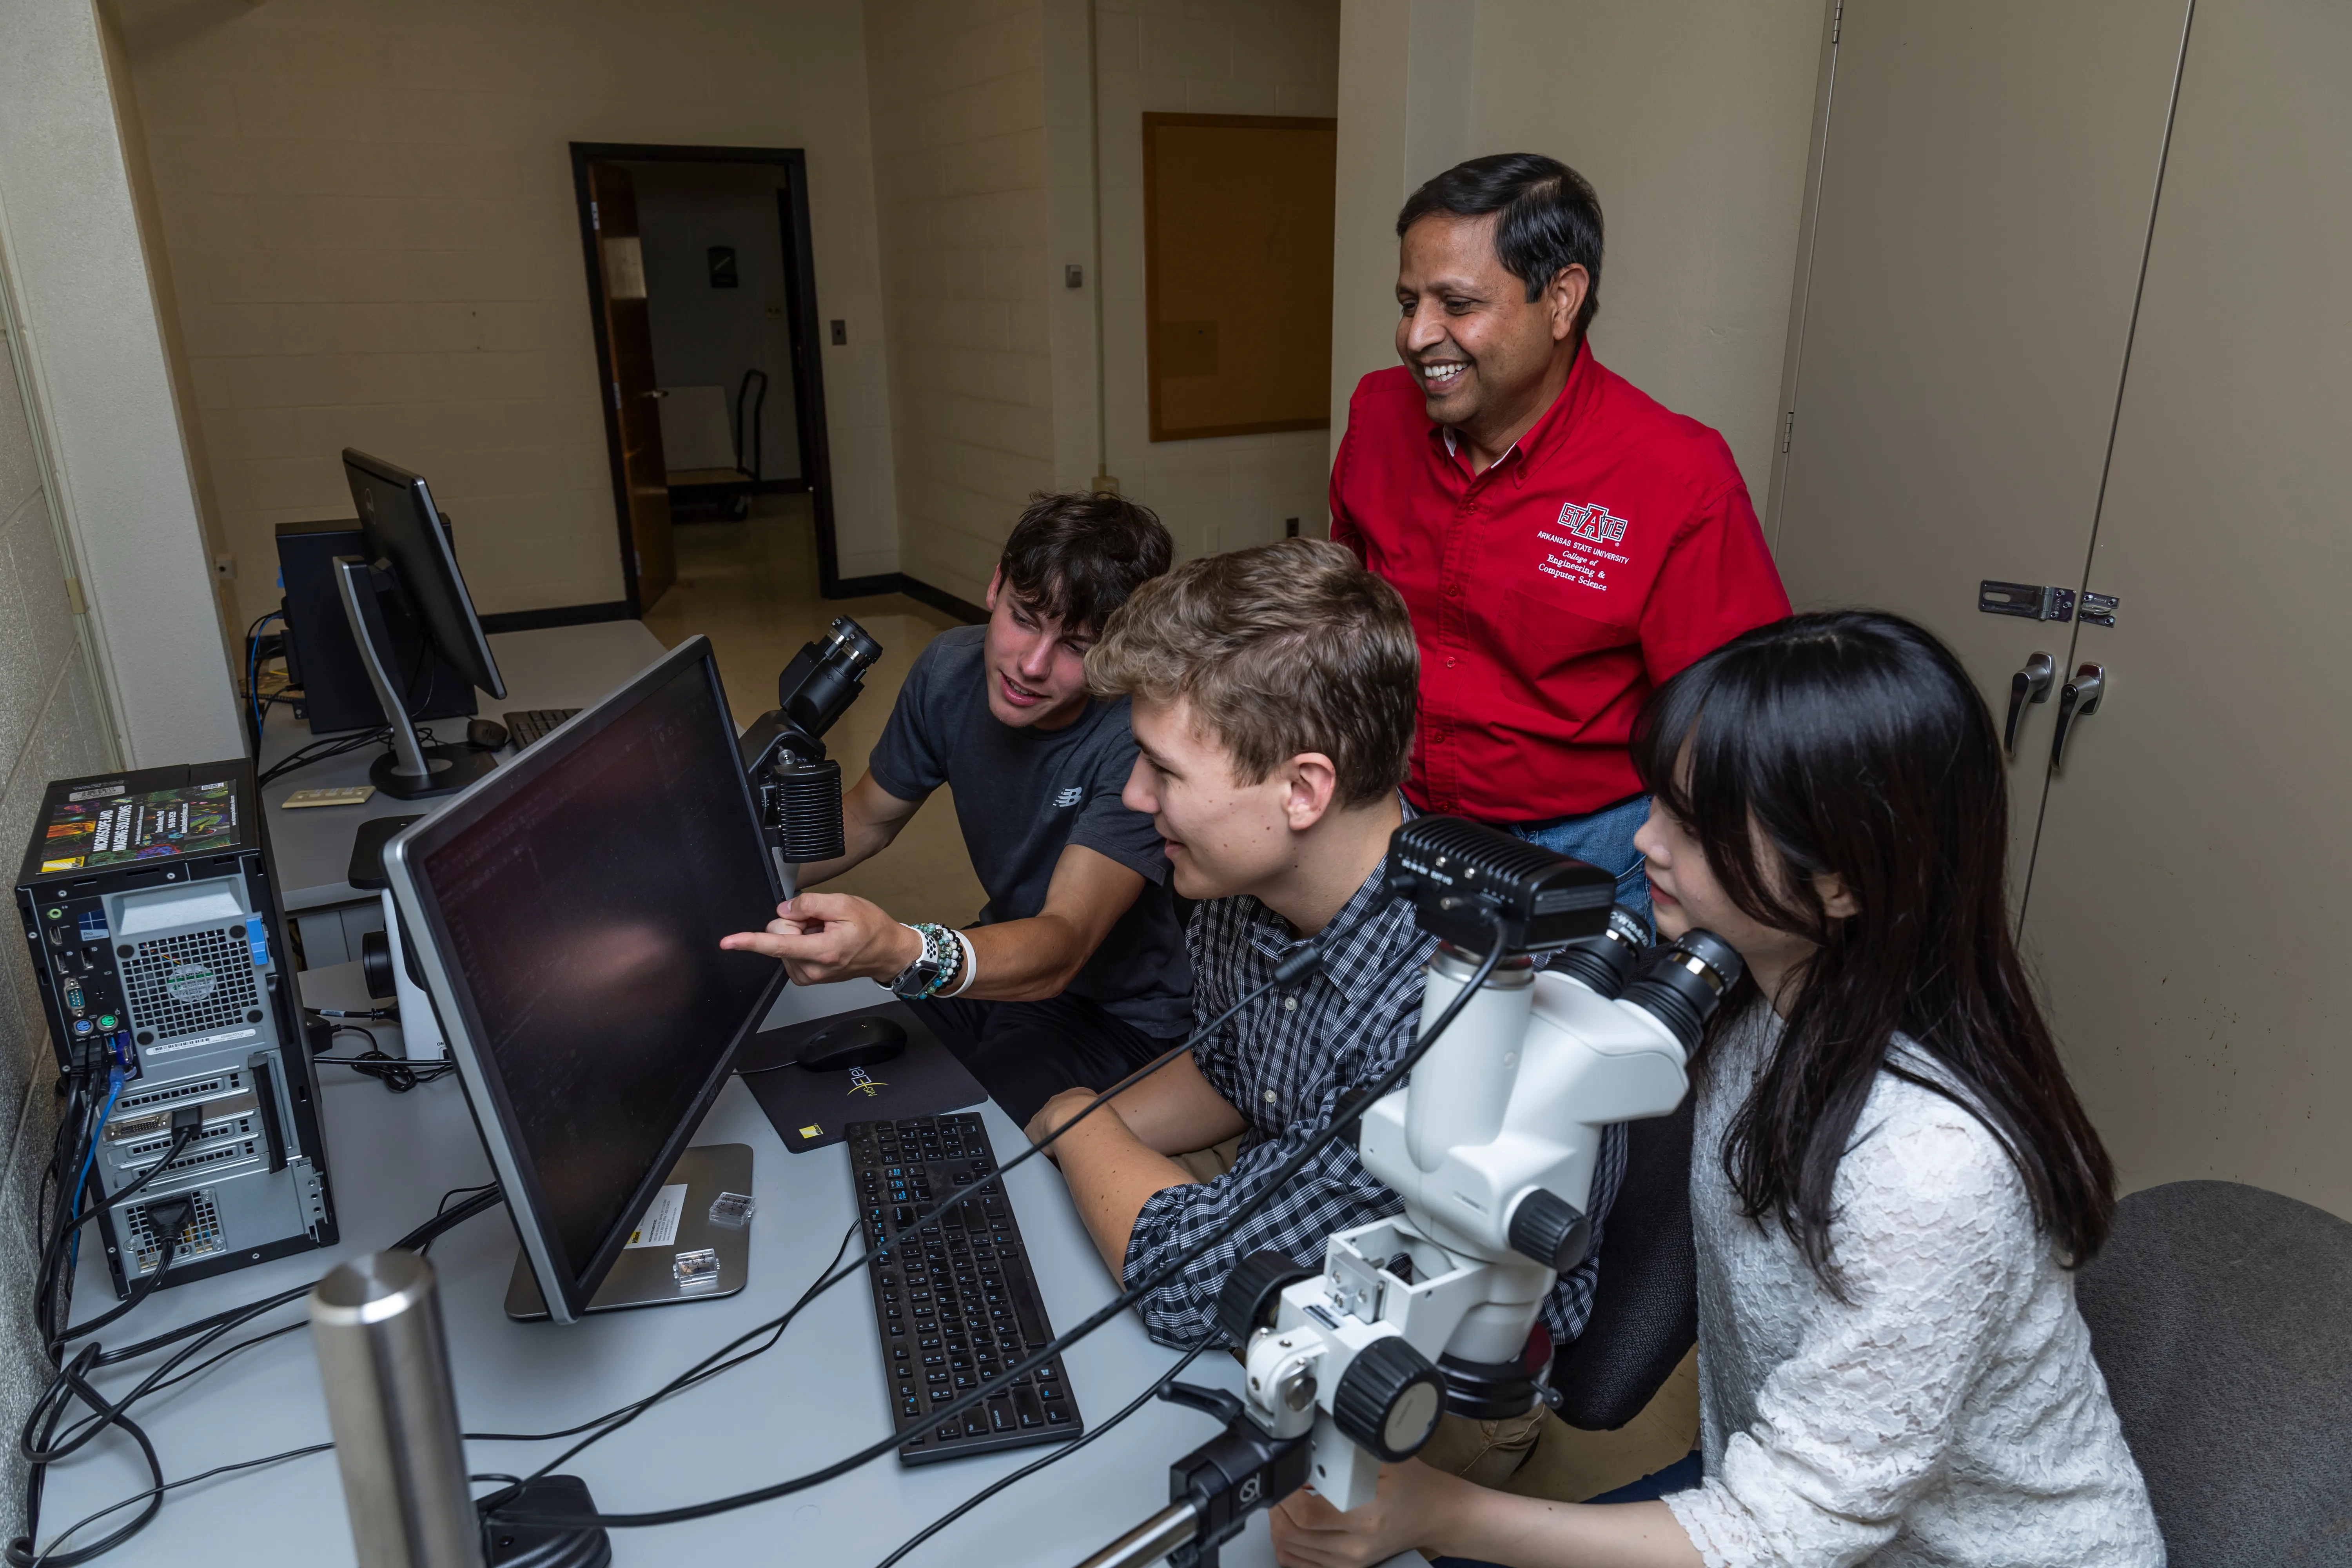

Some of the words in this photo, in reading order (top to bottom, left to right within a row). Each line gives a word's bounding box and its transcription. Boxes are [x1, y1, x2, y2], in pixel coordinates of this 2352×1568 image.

[1557, 503, 1628, 543] STATE
[1537, 531, 1571, 546] ARKANSAS
[1573, 542, 1592, 553] STATE
[1593, 548, 1630, 564] UNIVERSITY
[1563, 550, 1587, 564] College
[1539, 563, 1575, 581] Computer
[1578, 576, 1607, 591] Science
[1546, 554, 1595, 578] Engineering
[99, 810, 114, 820] AND
[115, 805, 132, 830] SOLUTIONS
[93, 819, 112, 852] MICROSCOPE
[112, 829, 129, 852] IMAGING
[863, 1087, 877, 1096] NIS
[632, 1231, 641, 1243] Nikon
